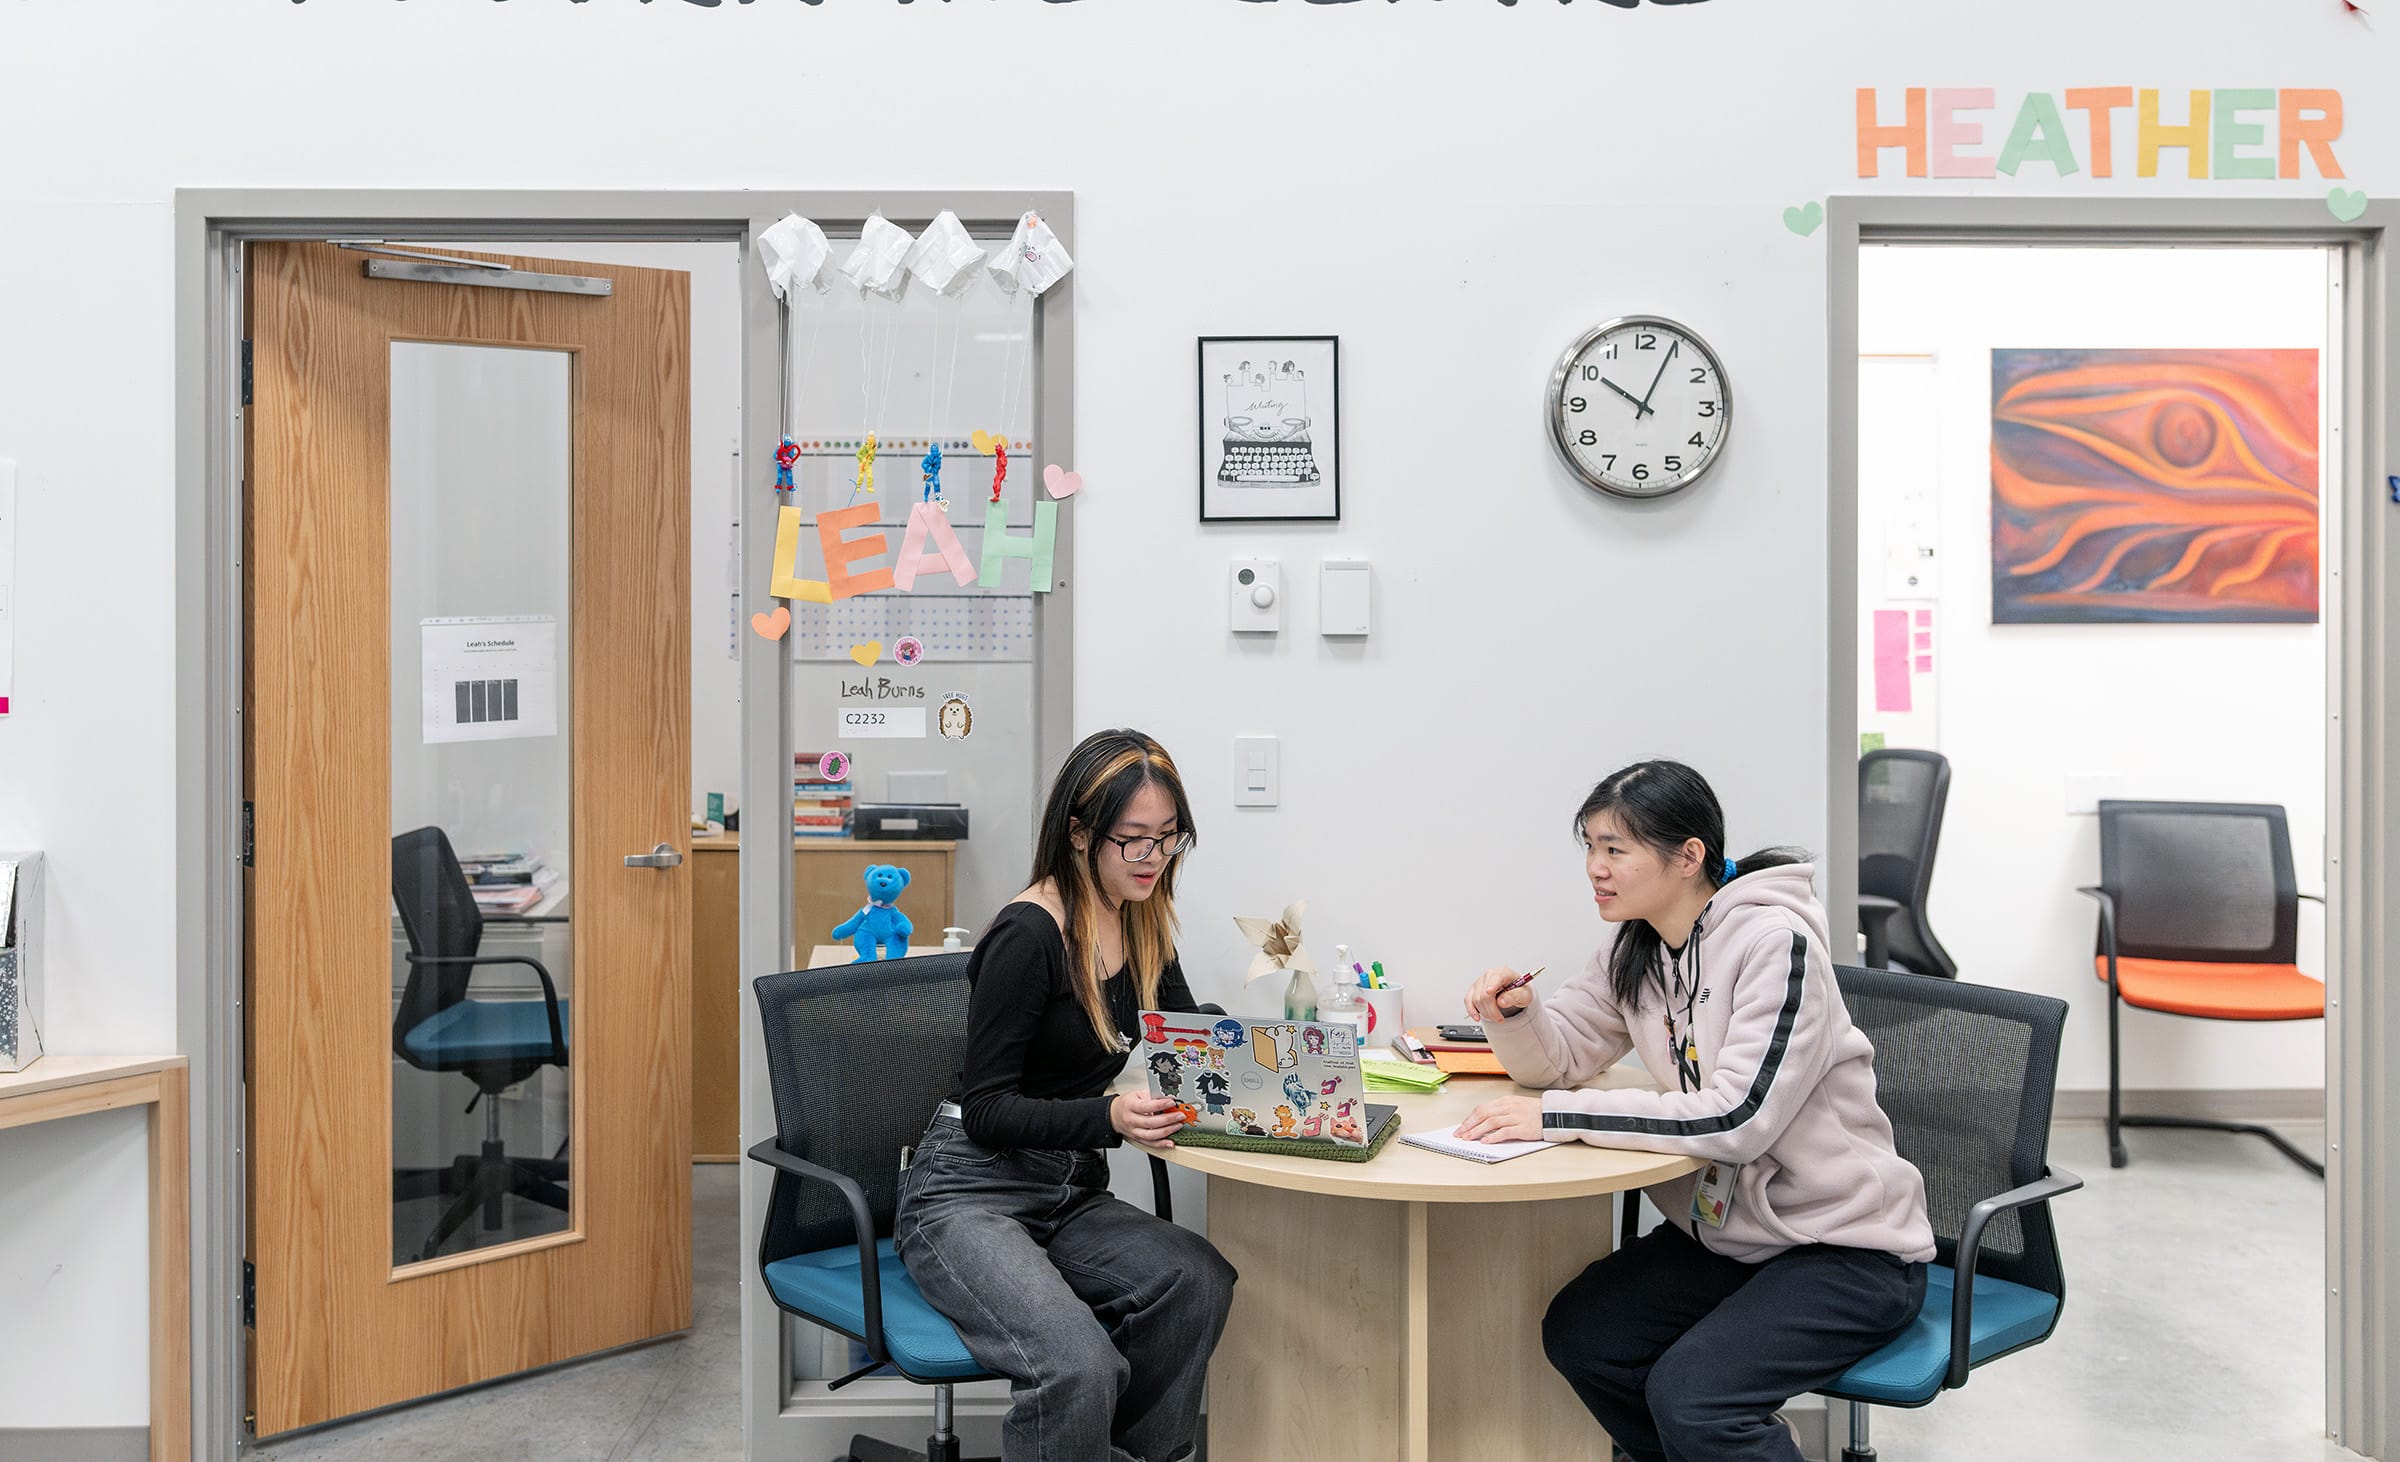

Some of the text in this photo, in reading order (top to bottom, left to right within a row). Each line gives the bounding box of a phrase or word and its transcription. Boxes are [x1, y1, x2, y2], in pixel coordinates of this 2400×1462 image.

[1856, 86, 2346, 179] HEATHER
[1635, 333, 1656, 350] 12
[1582, 365, 1599, 381] 10
[1689, 367, 1706, 384] 2
[1569, 396, 1587, 413] 9
[1697, 401, 1715, 417] 3
[1579, 429, 1597, 446] 8
[1687, 431, 1704, 448] 4
[1601, 454, 1617, 471] 7
[1664, 455, 1682, 472] 5
[1631, 463, 1649, 480] 6
[769, 498, 1059, 604] LEAH
[841, 676, 926, 700] Leah Burns
[845, 713, 886, 725] C2232
